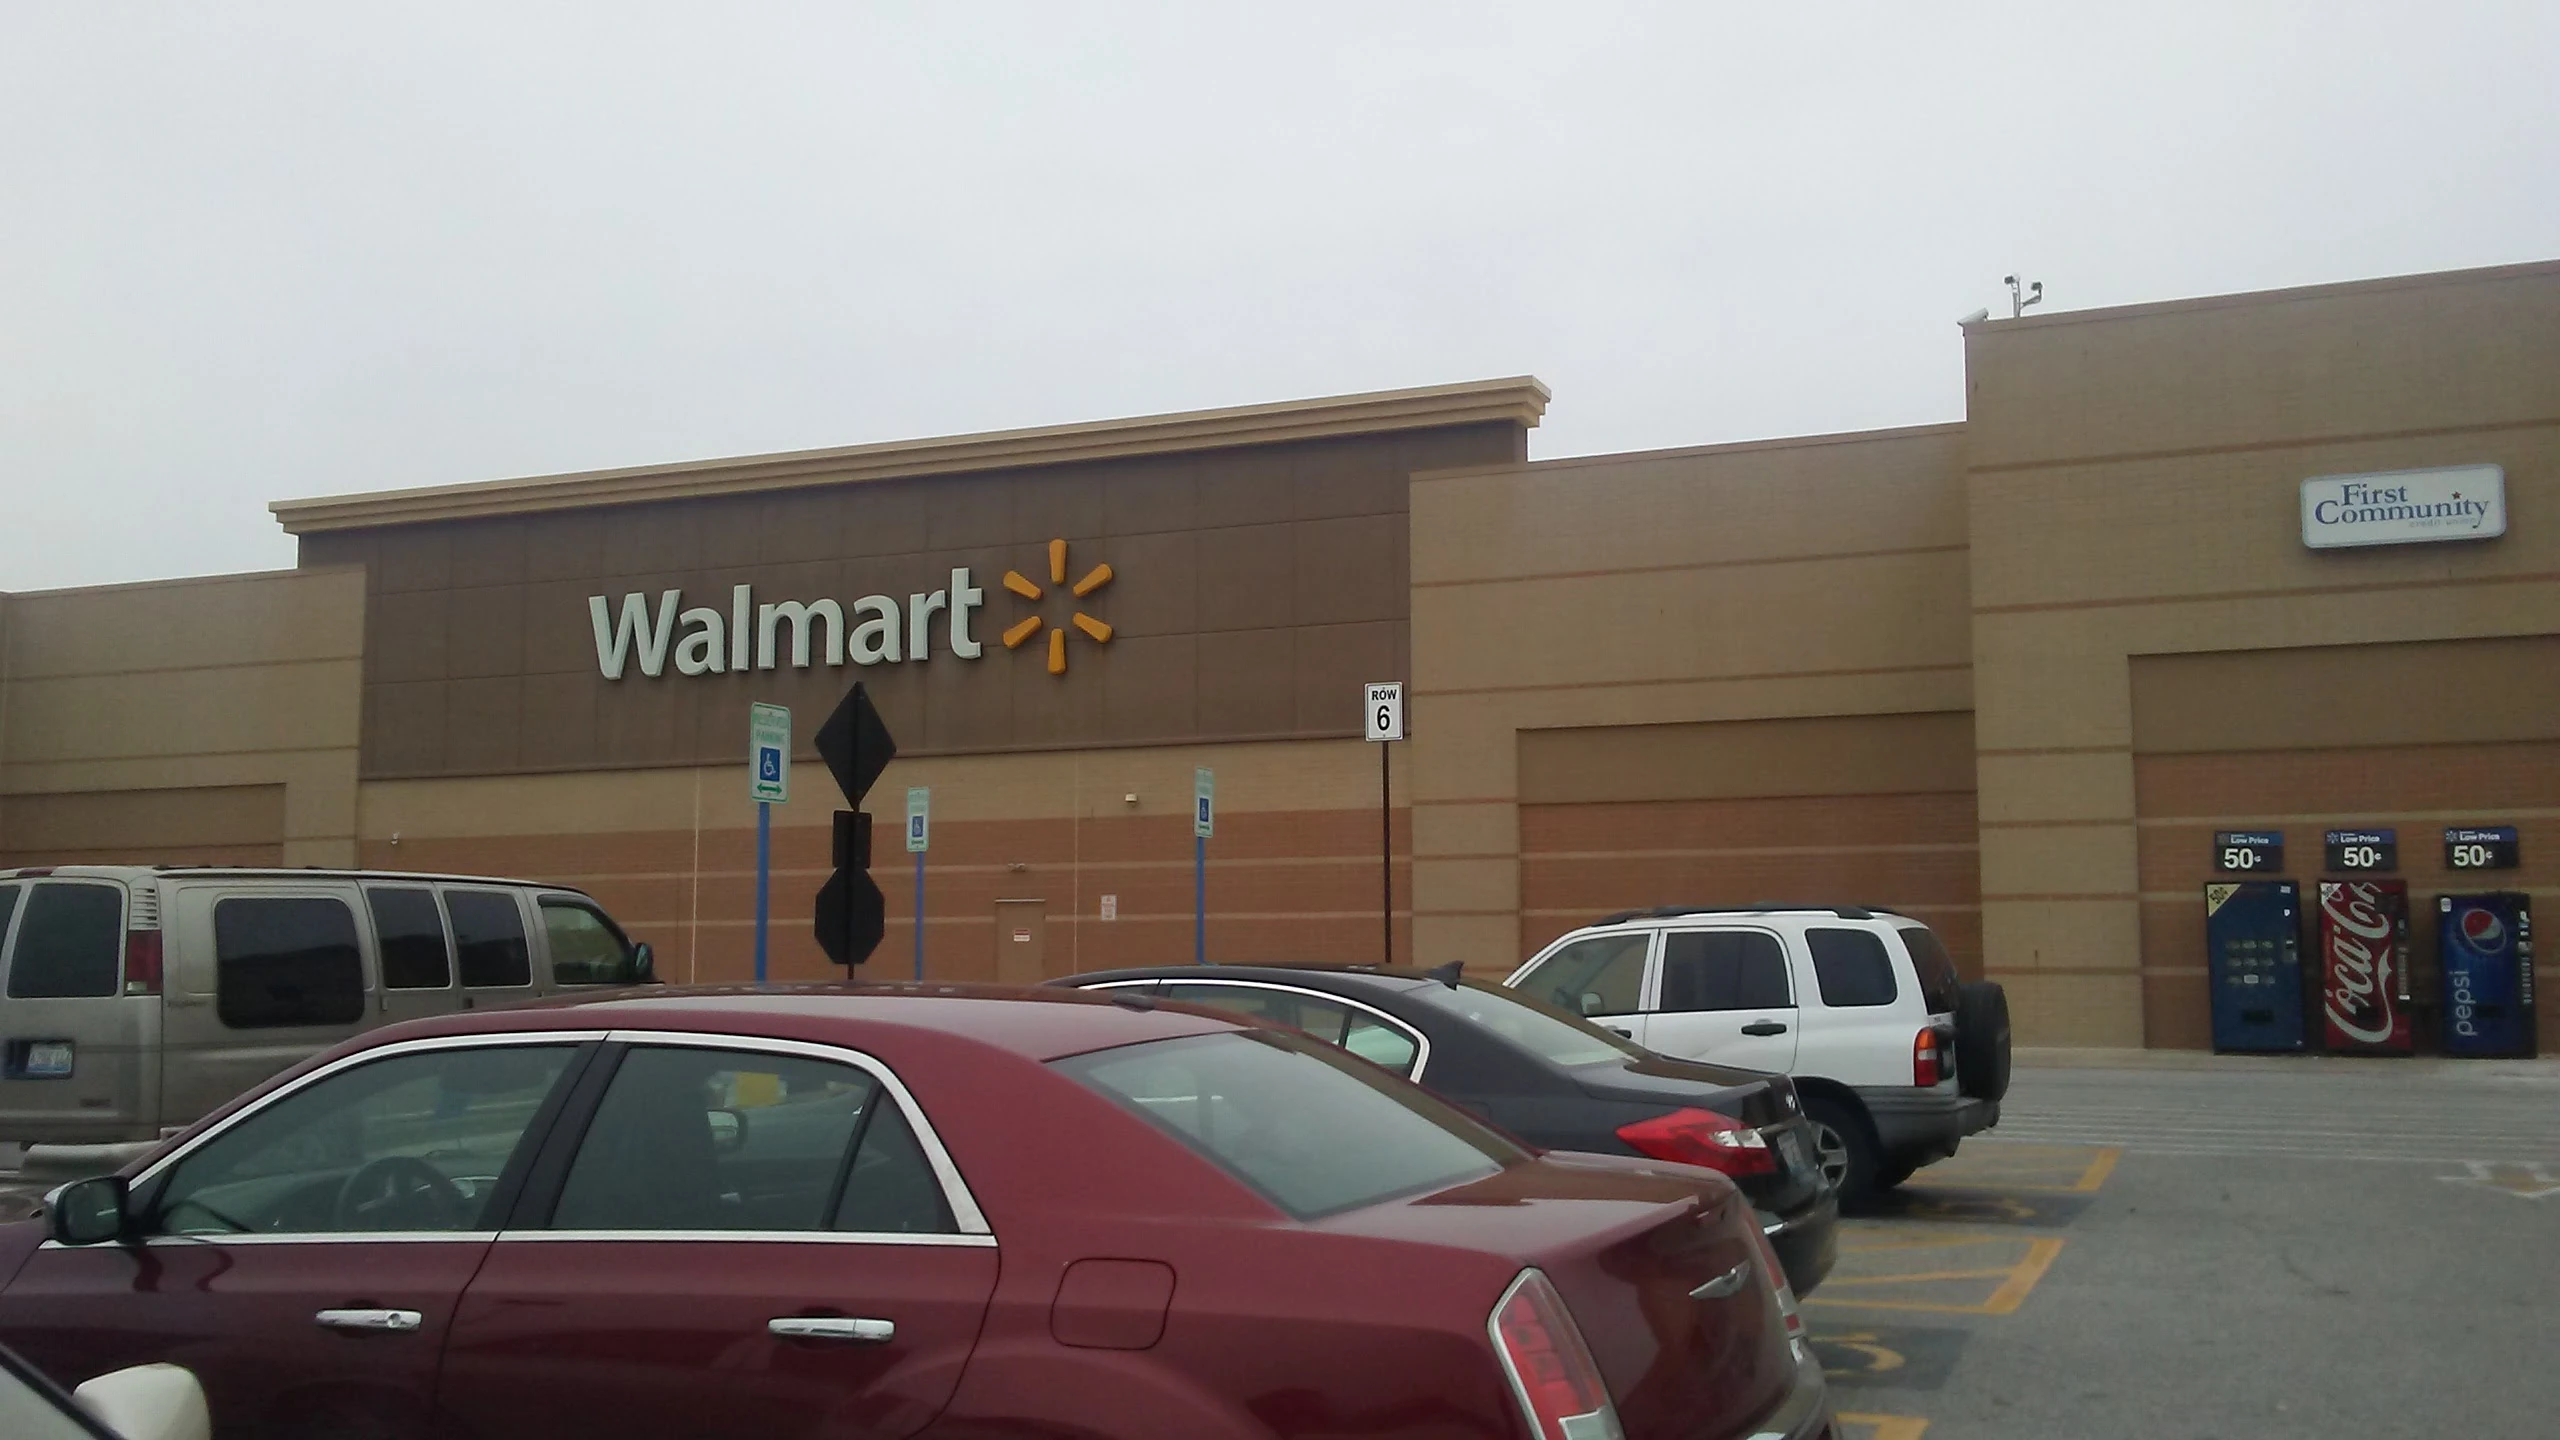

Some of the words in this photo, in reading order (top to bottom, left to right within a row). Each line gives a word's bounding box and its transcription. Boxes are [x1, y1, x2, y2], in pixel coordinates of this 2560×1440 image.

[2341, 483, 2408, 507] First
[2315, 496, 2489, 529] Community
[588, 567, 983, 681] Walmart
[1371, 689, 1397, 700] ROW
[1376, 704, 1391, 731] 6
[2230, 836, 2248, 844] Low
[2248, 836, 2270, 844] Price
[2340, 835, 2358, 843] Low
[2359, 834, 2380, 842] Price
[2460, 833, 2478, 841] Low
[2478, 832, 2500, 840] Price
[2449, 969, 2479, 1037] pepsi
